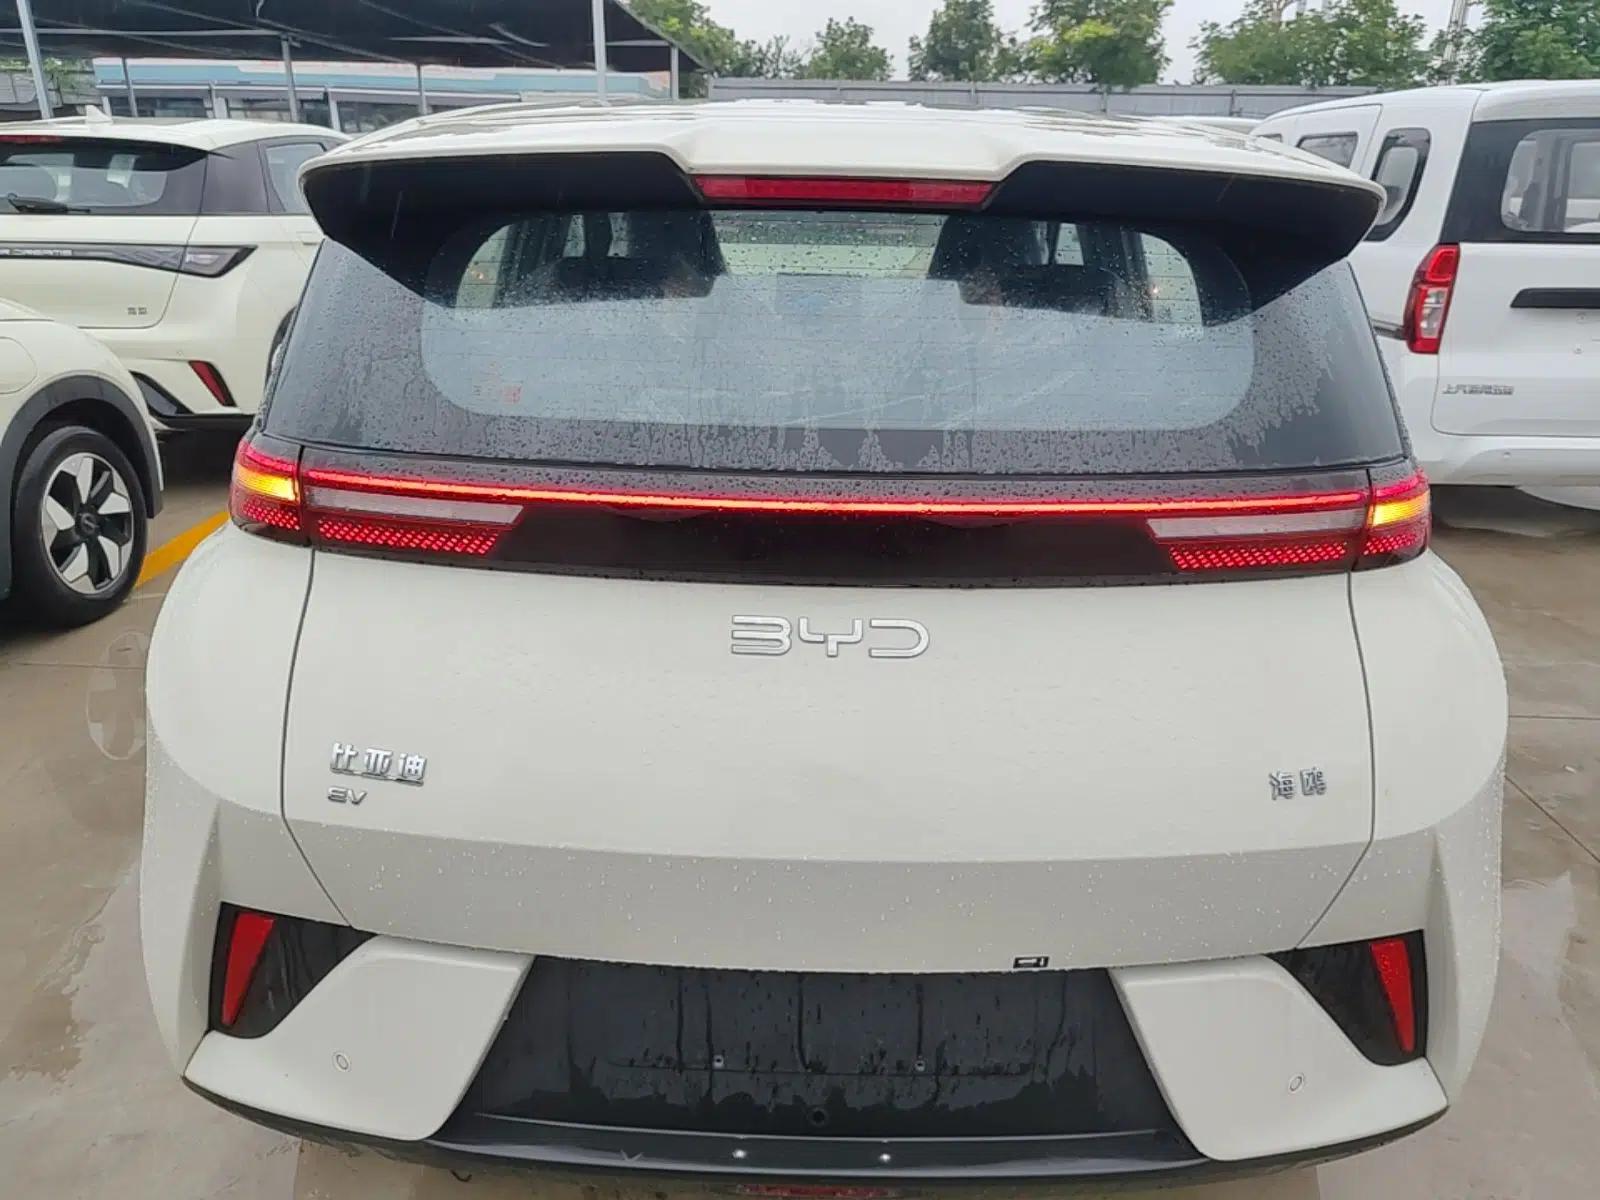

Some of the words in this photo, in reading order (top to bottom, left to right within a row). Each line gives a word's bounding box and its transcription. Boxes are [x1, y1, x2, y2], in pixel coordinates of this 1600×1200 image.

[731, 614, 930, 659] BYD
[329, 741, 428, 787] 比亚迪
[327, 786, 367, 806] EV
